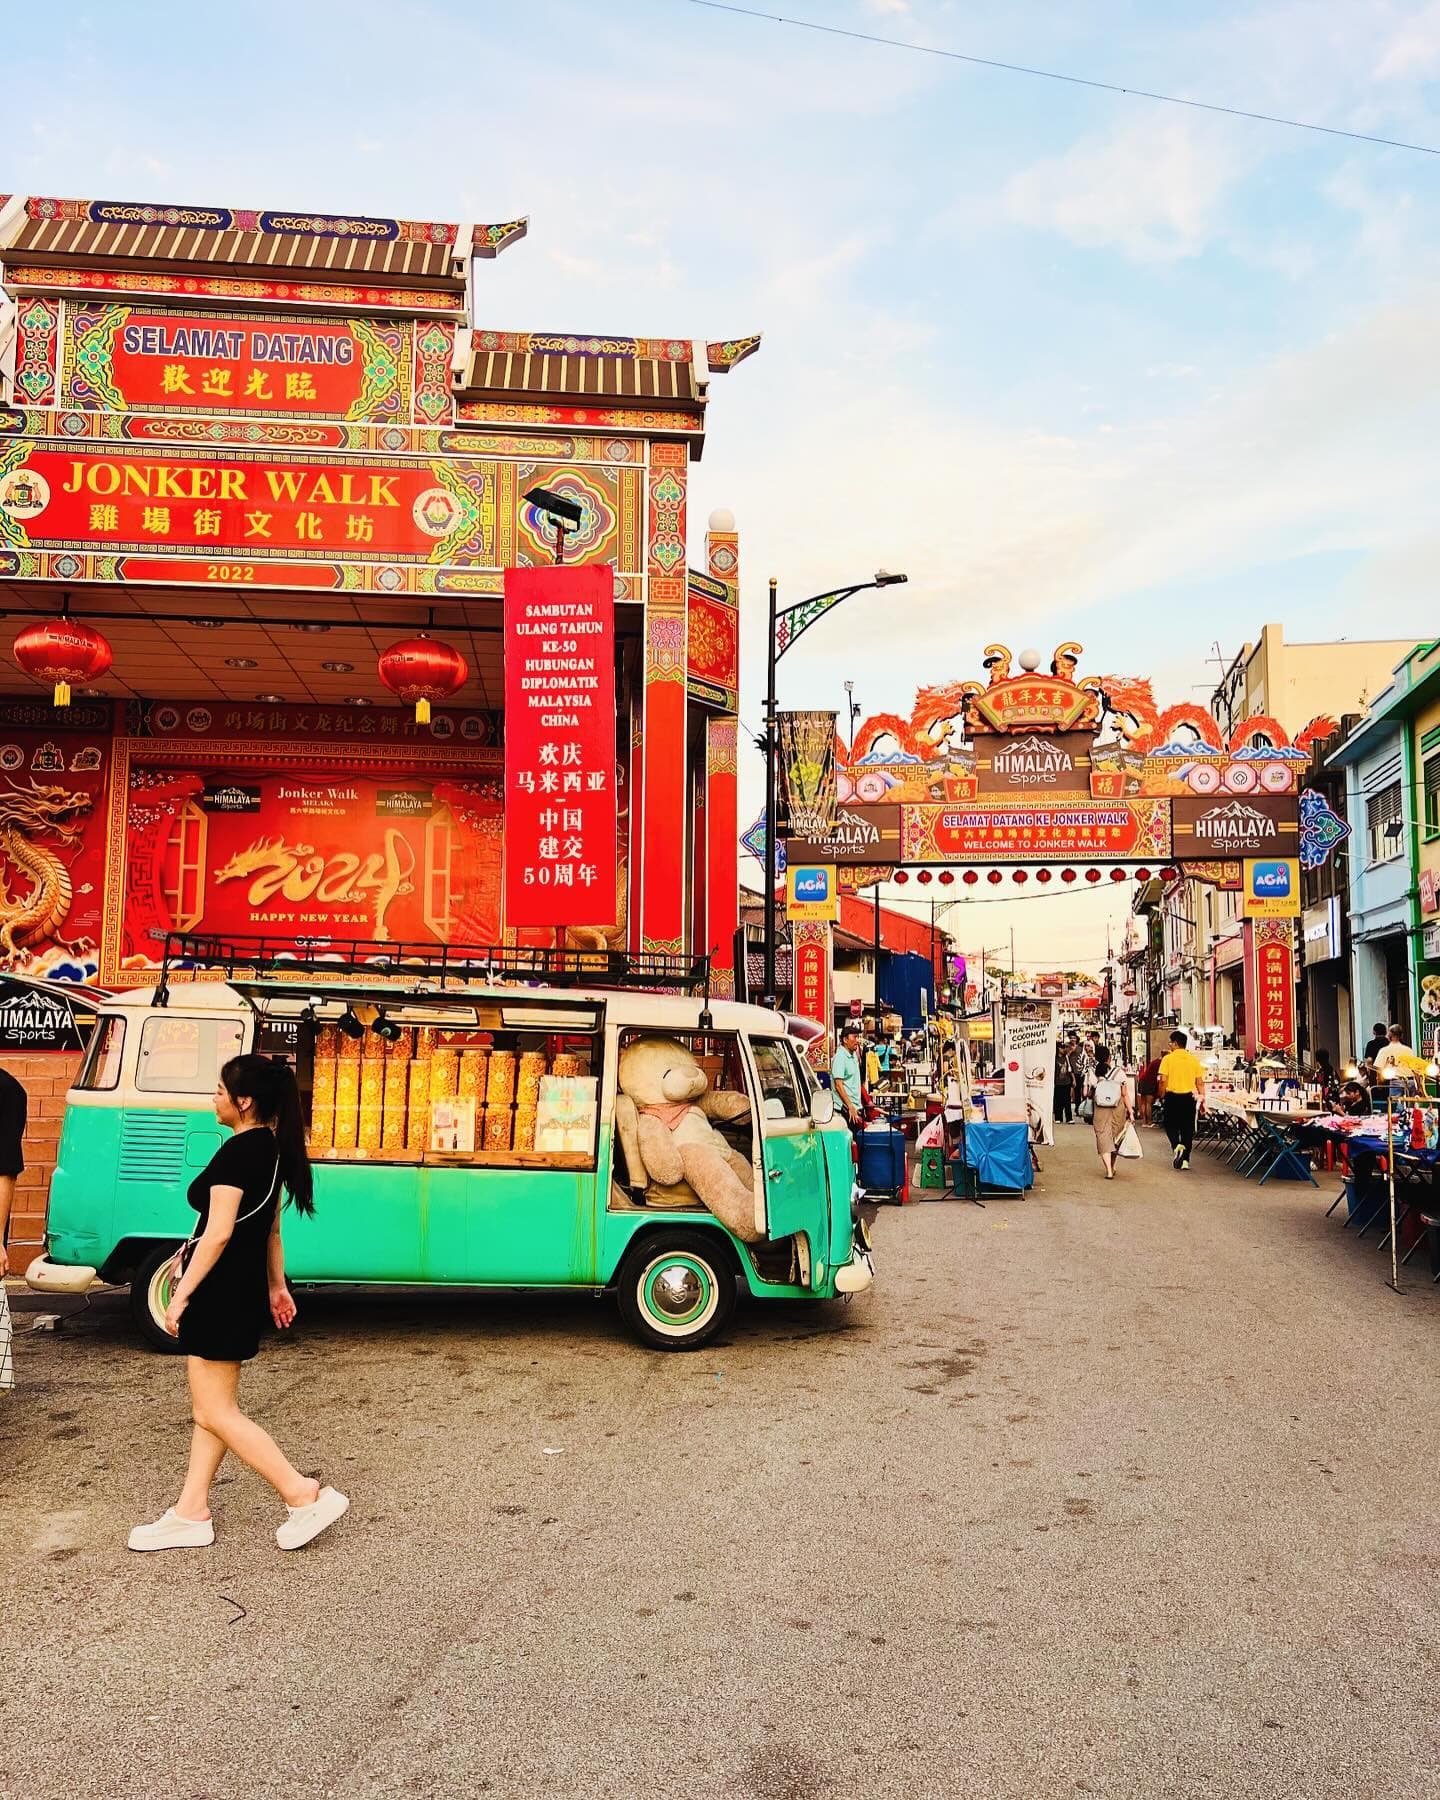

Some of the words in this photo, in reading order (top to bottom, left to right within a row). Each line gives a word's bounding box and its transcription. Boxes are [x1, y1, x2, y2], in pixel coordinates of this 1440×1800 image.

[124, 325, 246, 360] SELAMAT
[251, 331, 354, 366] DATANG
[160, 364, 317, 401] 歡迎光臨
[63, 461, 249, 501] JONKER
[264, 470, 401, 507] WALK
[88, 504, 374, 543] 雞場街文化坊
[207, 565, 254, 581] 2022
[525, 604, 593, 617] SAMBUTAN
[516, 623, 558, 635] ULANG
[560, 622, 603, 634] TAHUN
[542, 641, 578, 653] KE-50
[525, 658, 595, 671] HUBUNGAN
[521, 676, 599, 689] DIPLOMATIK
[528, 695, 592, 708] MALAYSIA
[1001, 689, 1064, 706] 龍年大吉
[541, 715, 580, 727] CHINA
[538, 742, 583, 766] 欢庆
[993, 753, 1073, 773] HIMALAYA
[515, 770, 607, 794] 马来西亚
[1008, 772, 1057, 788] Sports
[1097, 776, 1114, 795] 福
[278, 787, 323, 799] Jonker
[327, 788, 359, 800] Walk
[953, 782, 971, 799] 福
[214, 794, 251, 804] HIMALAYA
[386, 799, 422, 809] HIMALAYA
[539, 808, 583, 832] 中国
[787, 819, 828, 829] HIMALAYA
[943, 814, 990, 828] SELAMAT
[992, 812, 1034, 827] DATANG
[1034, 812, 1051, 827] KE
[1052, 812, 1096, 826] JONKER
[1096, 811, 1129, 826] WALK
[1196, 819, 1276, 838] HIMALAYA
[538, 836, 583, 860] 建交
[820, 843, 866, 860] Sports
[963, 840, 1015, 850] WELCOME
[1017, 840, 1031, 848] TO
[1033, 839, 1075, 849] JONKER
[1077, 839, 1107, 848] WALK
[1211, 838, 1260, 854] Sports
[523, 863, 598, 887] 50周年
[1255, 873, 1288, 886] AGM
[797, 879, 826, 891] AGM
[249, 912, 295, 922] HAPPY
[300, 914, 329, 923] NEW
[332, 914, 369, 923] YEAR
[803, 948, 818, 1021] 龙腾盛世千
[1266, 948, 1285, 1044] 春满甲州万物荣
[0, 1009, 72, 1029] IMALAYA
[5, 1027, 56, 1045] Sports
[1011, 1030, 1046, 1042] COCONUT
[1022, 1038, 1048, 1048] CREAM
